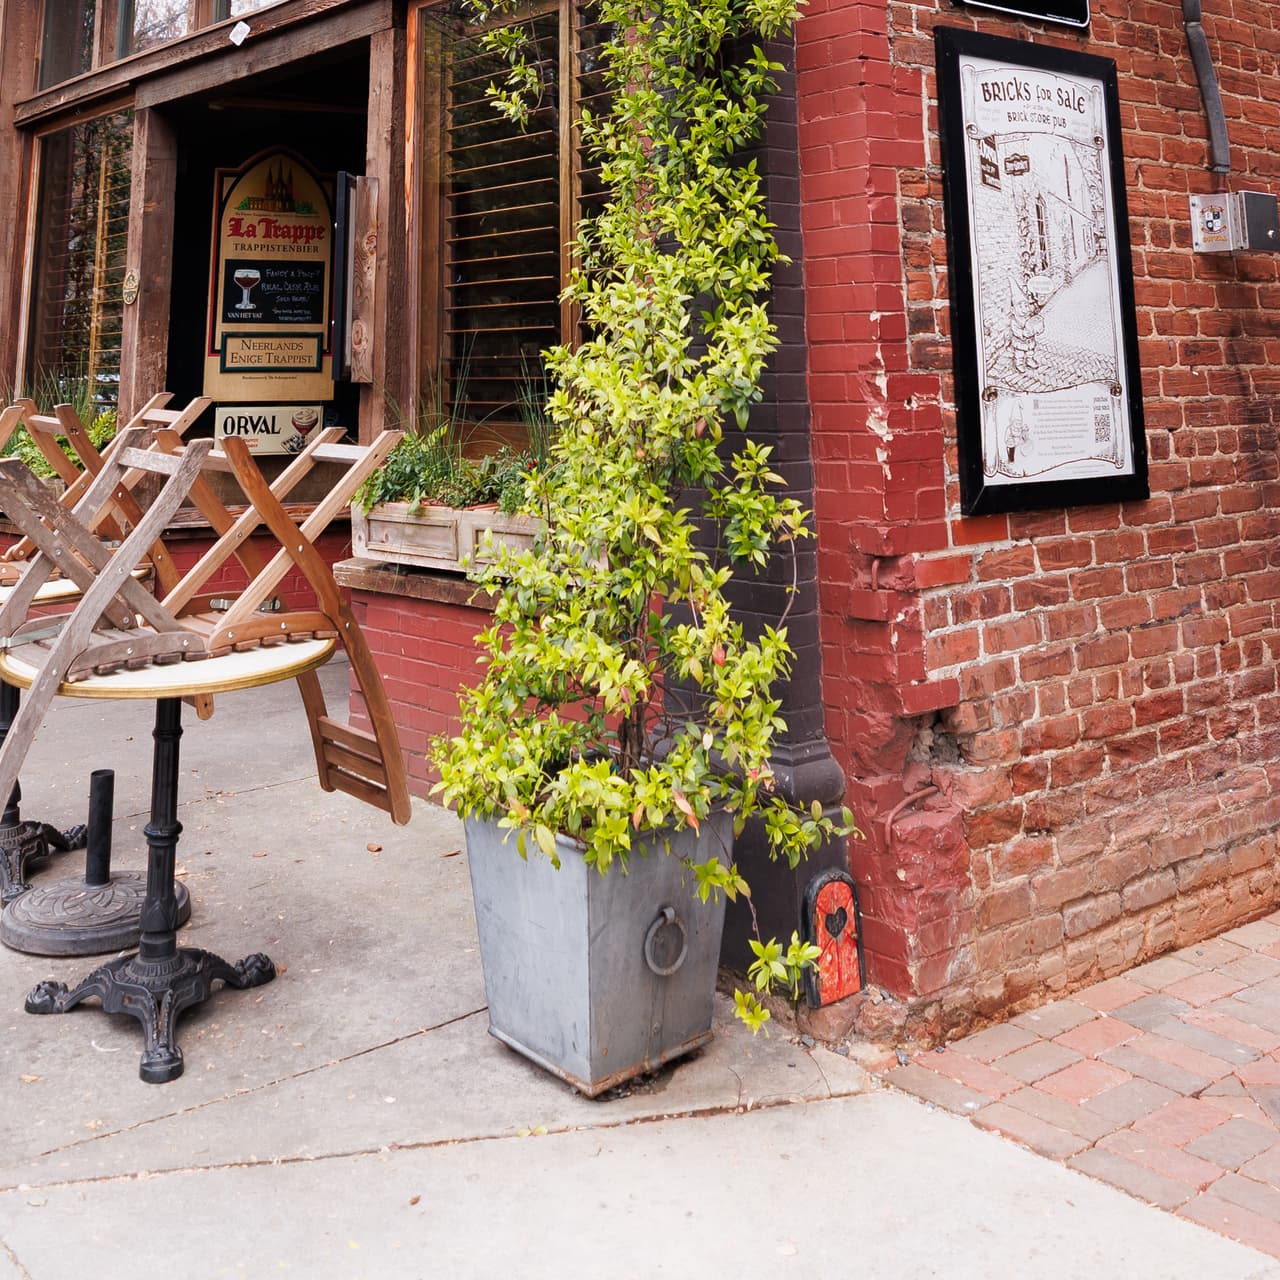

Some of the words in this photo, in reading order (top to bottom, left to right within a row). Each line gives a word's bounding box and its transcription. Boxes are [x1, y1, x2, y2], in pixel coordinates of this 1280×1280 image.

[1007, 110, 1029, 123] BRICK
[227, 216, 257, 238] La
[258, 217, 325, 244] Trappe
[233, 243, 320, 253] TRAPPISTENBIER
[223, 415, 281, 436] ORVAL
